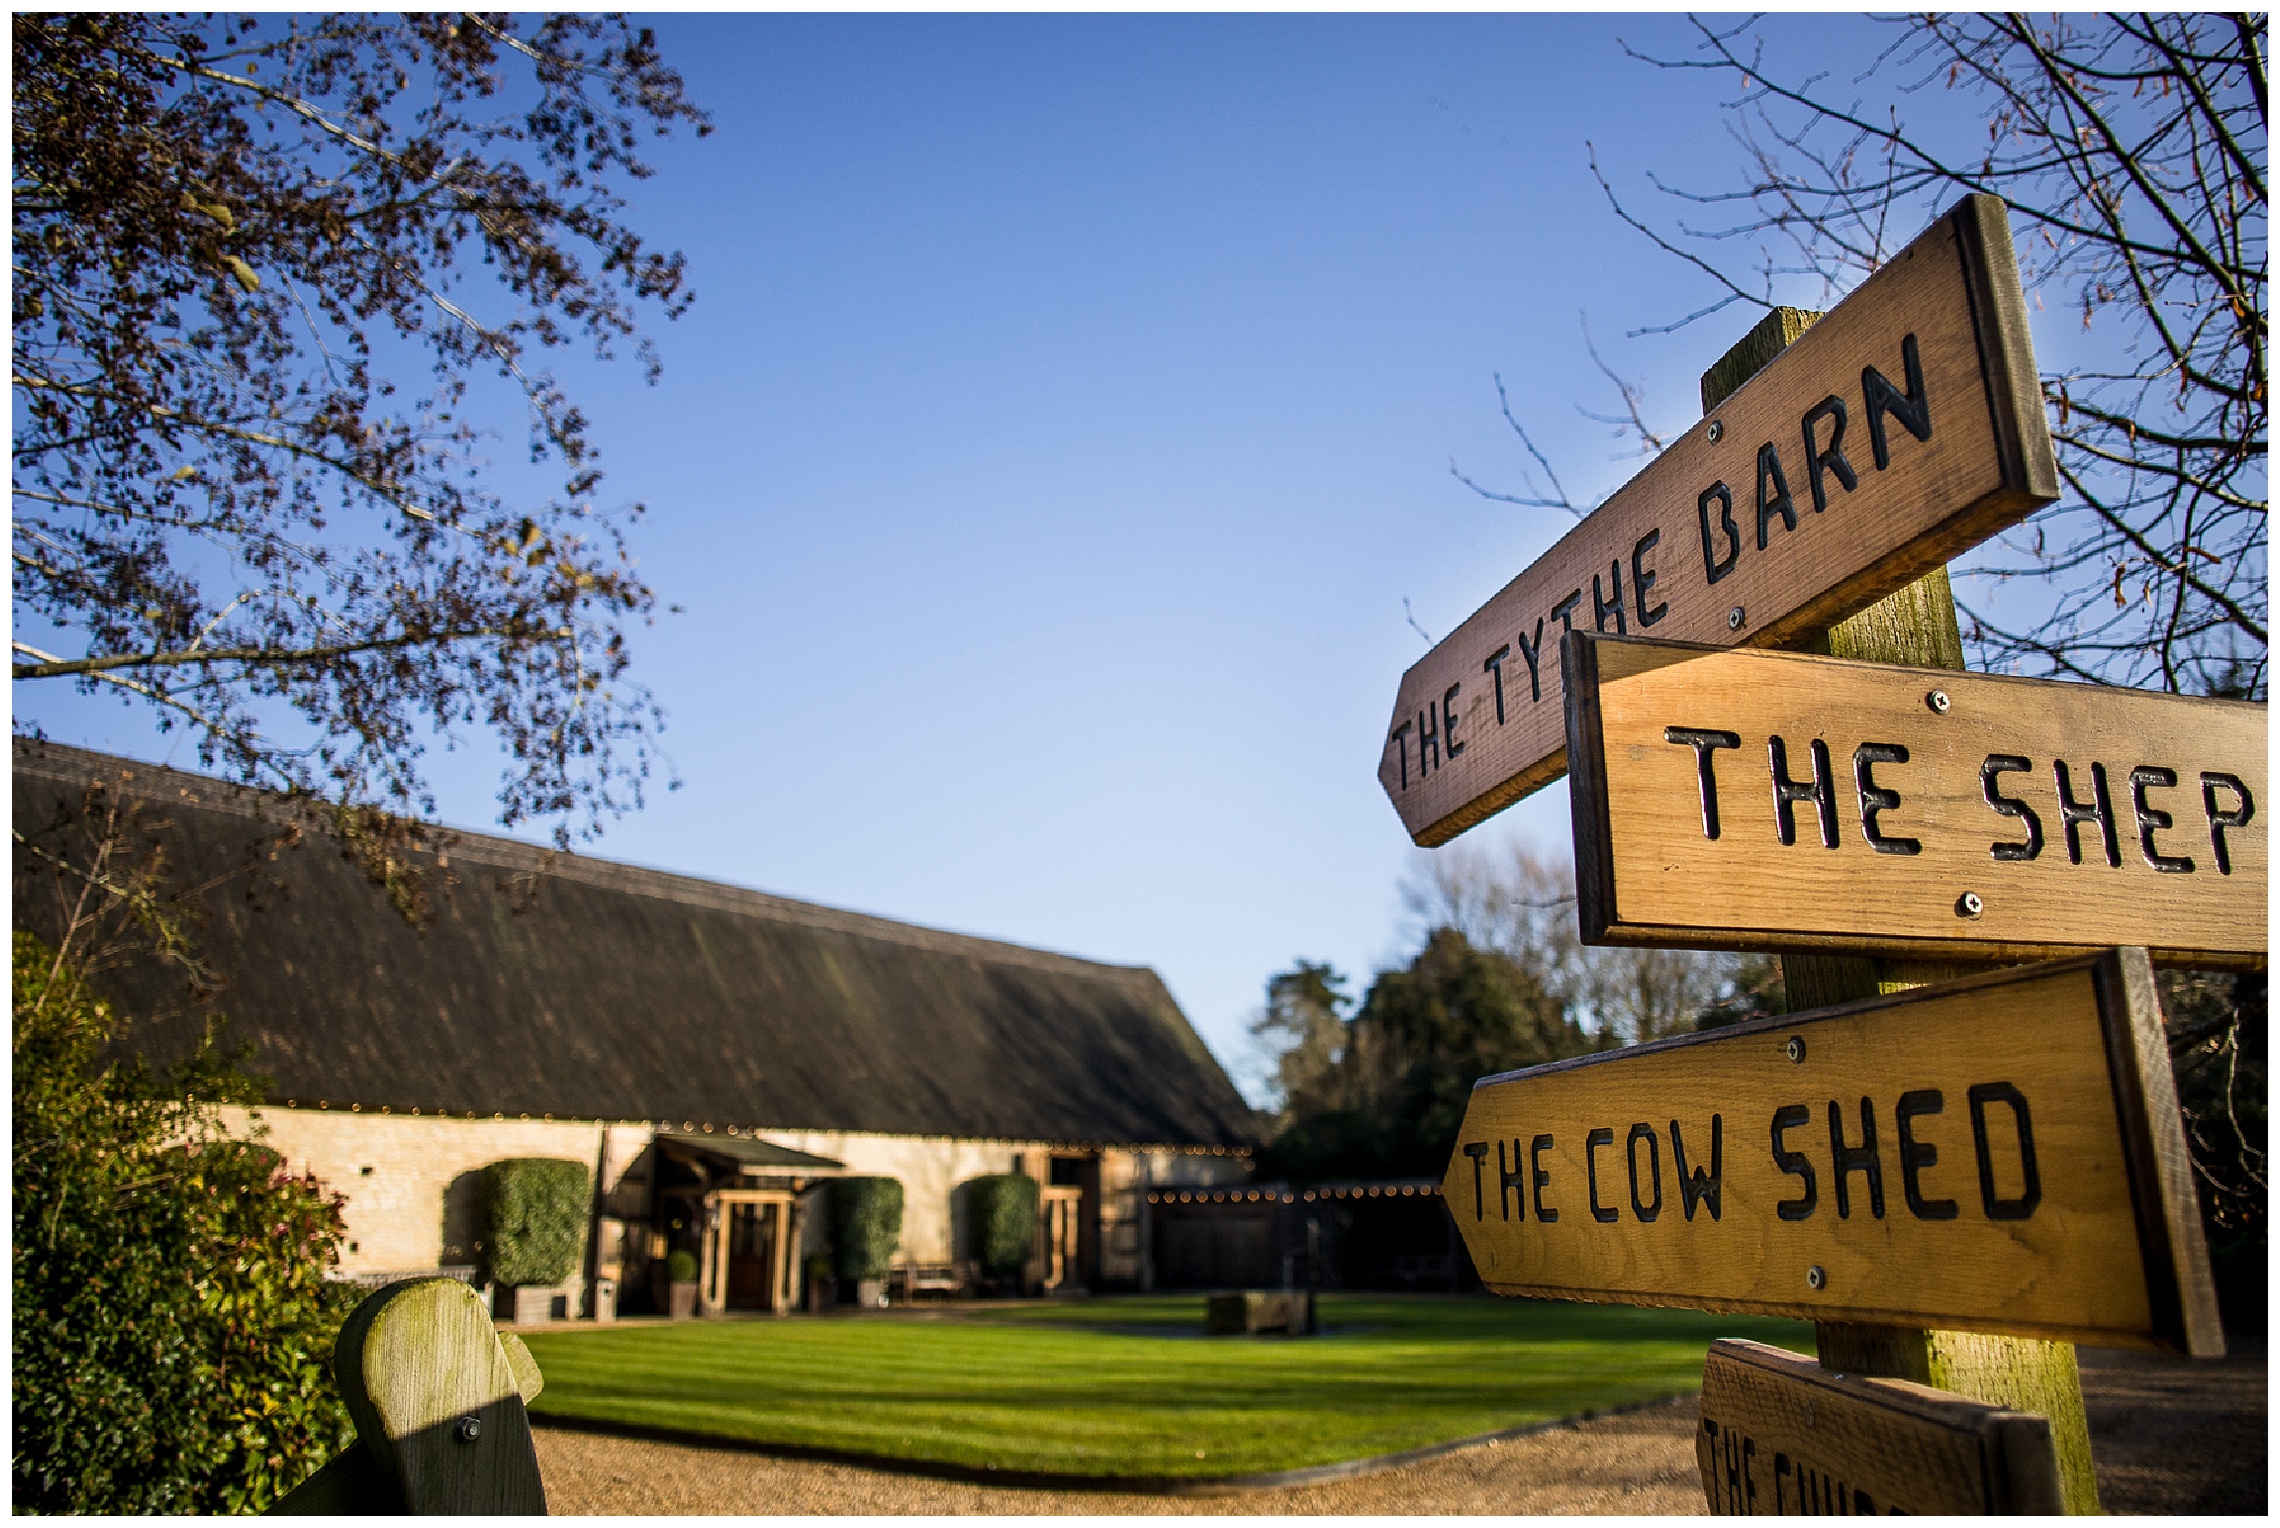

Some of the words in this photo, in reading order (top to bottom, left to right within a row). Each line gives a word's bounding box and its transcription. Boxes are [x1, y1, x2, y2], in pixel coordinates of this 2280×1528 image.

[1391, 681, 1467, 792] THE
[1698, 333, 1933, 585] BARN
[1664, 725, 1922, 857] THE
[1979, 752, 2255, 876] SHEP
[1463, 1132, 1559, 1223] THE
[1586, 1112, 1722, 1223] COW
[1770, 1080, 2042, 1222] SHED
[1703, 1416, 1756, 1516] THE
